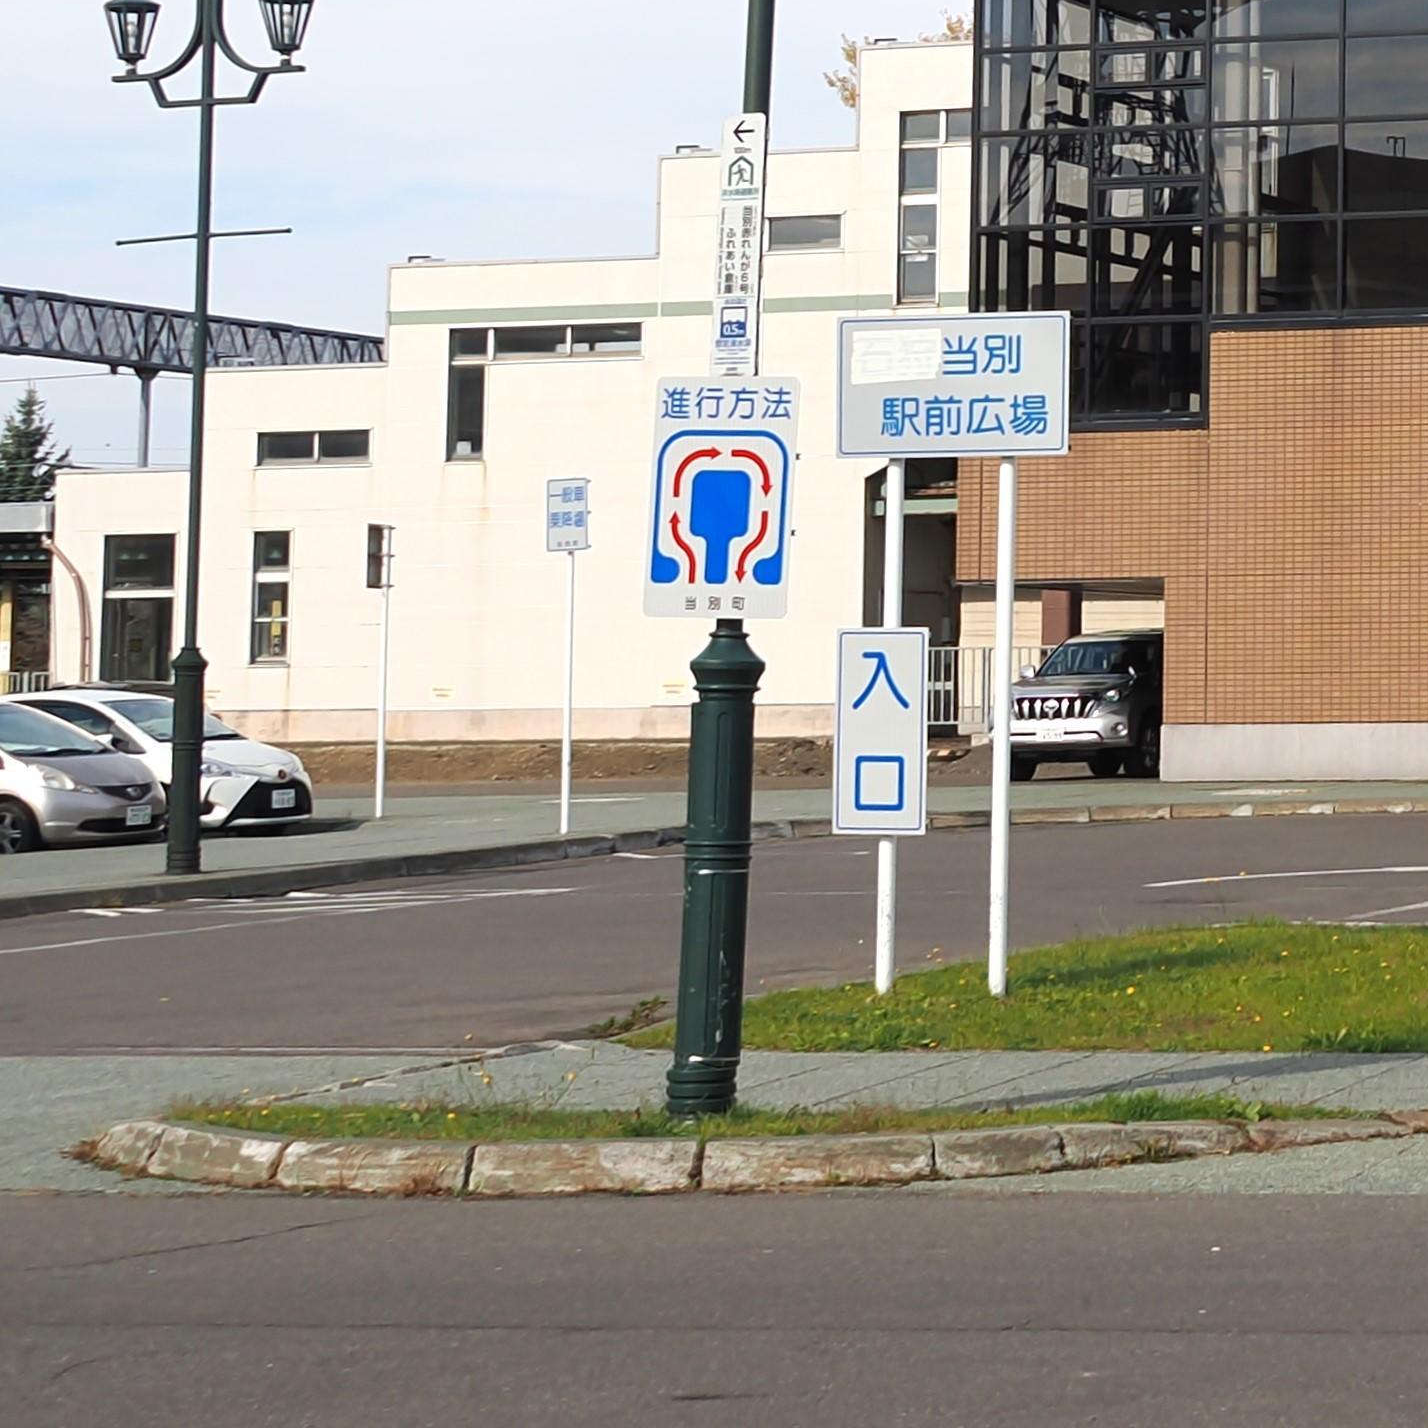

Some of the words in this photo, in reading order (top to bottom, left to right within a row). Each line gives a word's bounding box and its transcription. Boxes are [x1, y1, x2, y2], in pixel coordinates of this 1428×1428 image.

[661, 387, 792, 420] 進行方法
[881, 394, 1048, 437] 駅前広場
[685, 596, 745, 610] 当別町
[852, 652, 910, 811] 入口
